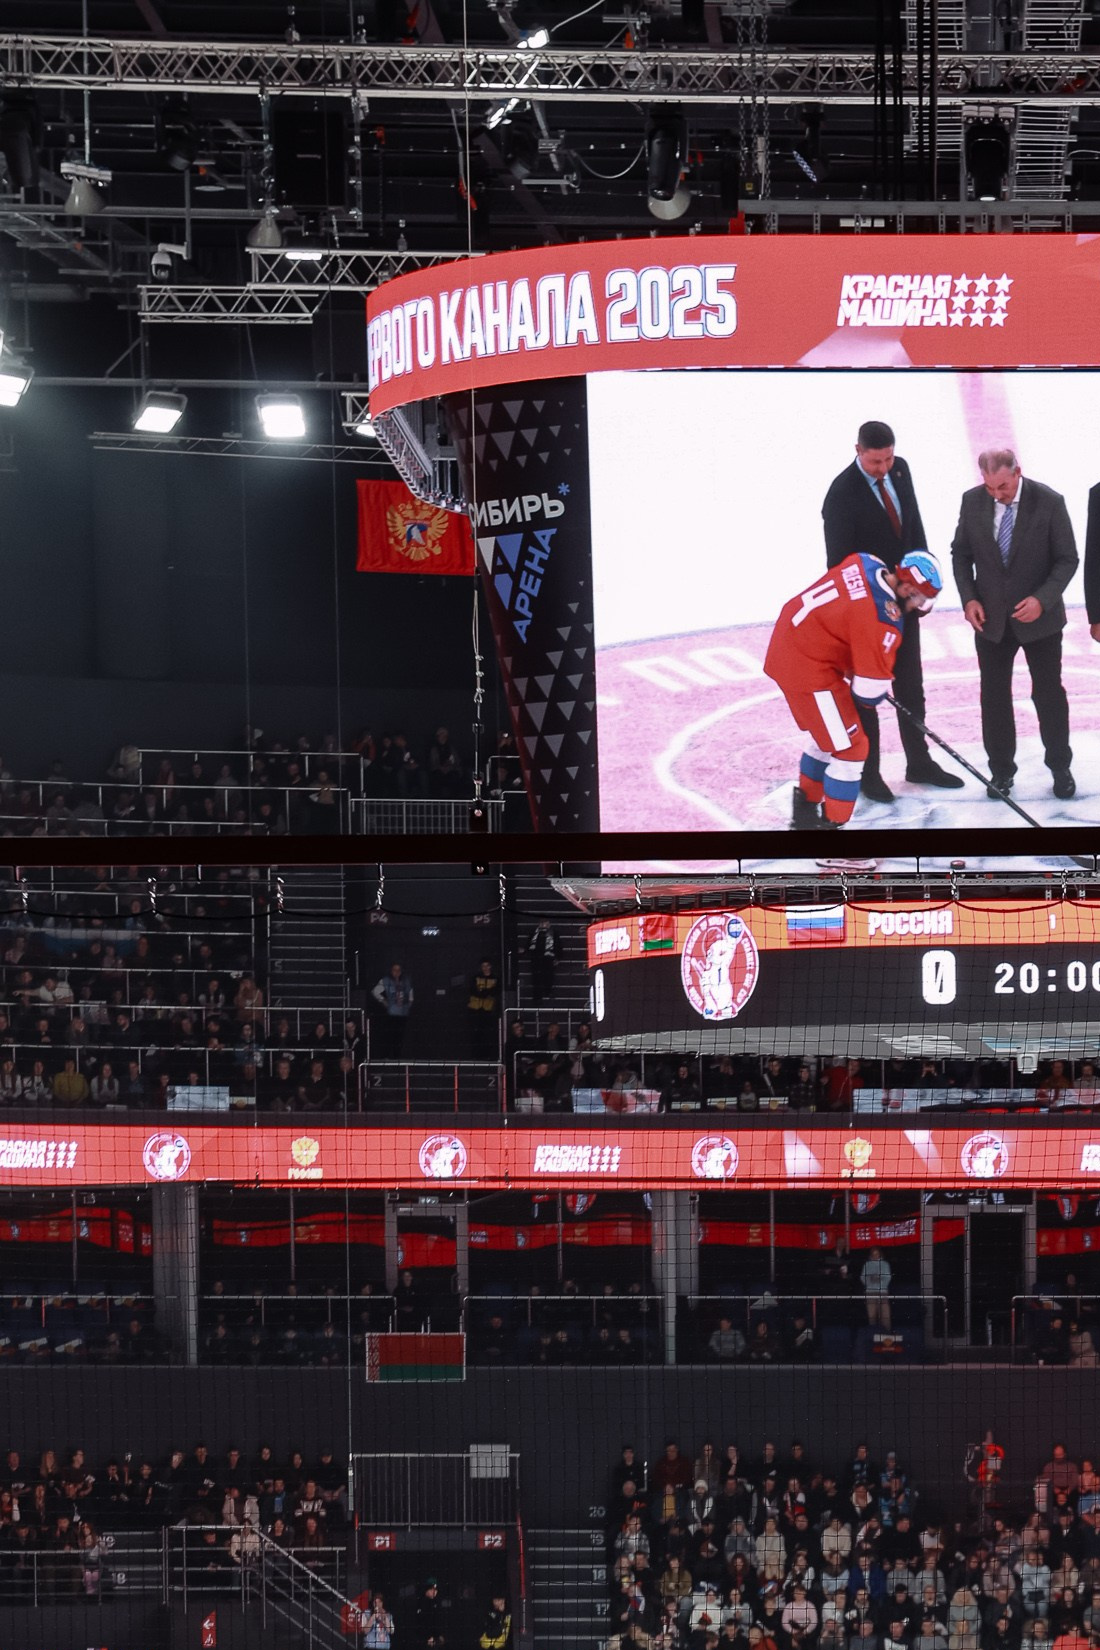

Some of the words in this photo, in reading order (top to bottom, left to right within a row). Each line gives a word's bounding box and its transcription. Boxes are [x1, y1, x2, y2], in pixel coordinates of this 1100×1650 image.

[841, 273, 952, 299] КРАСНАЯ
[439, 271, 600, 365] КАНАЛА
[606, 264, 738, 343] 2025
[836, 299, 950, 327] МАШИНА
[468, 492, 566, 528] СИБИРЬ
[512, 528, 558, 645] АРЕНА
[791, 579, 840, 628] 4
[881, 631, 897, 654] 4
[868, 910, 954, 937] РОССИЯ
[1048, 914, 1057, 930] 1
[921, 949, 957, 1006] 0
[375, 1535, 390, 1548] P1
